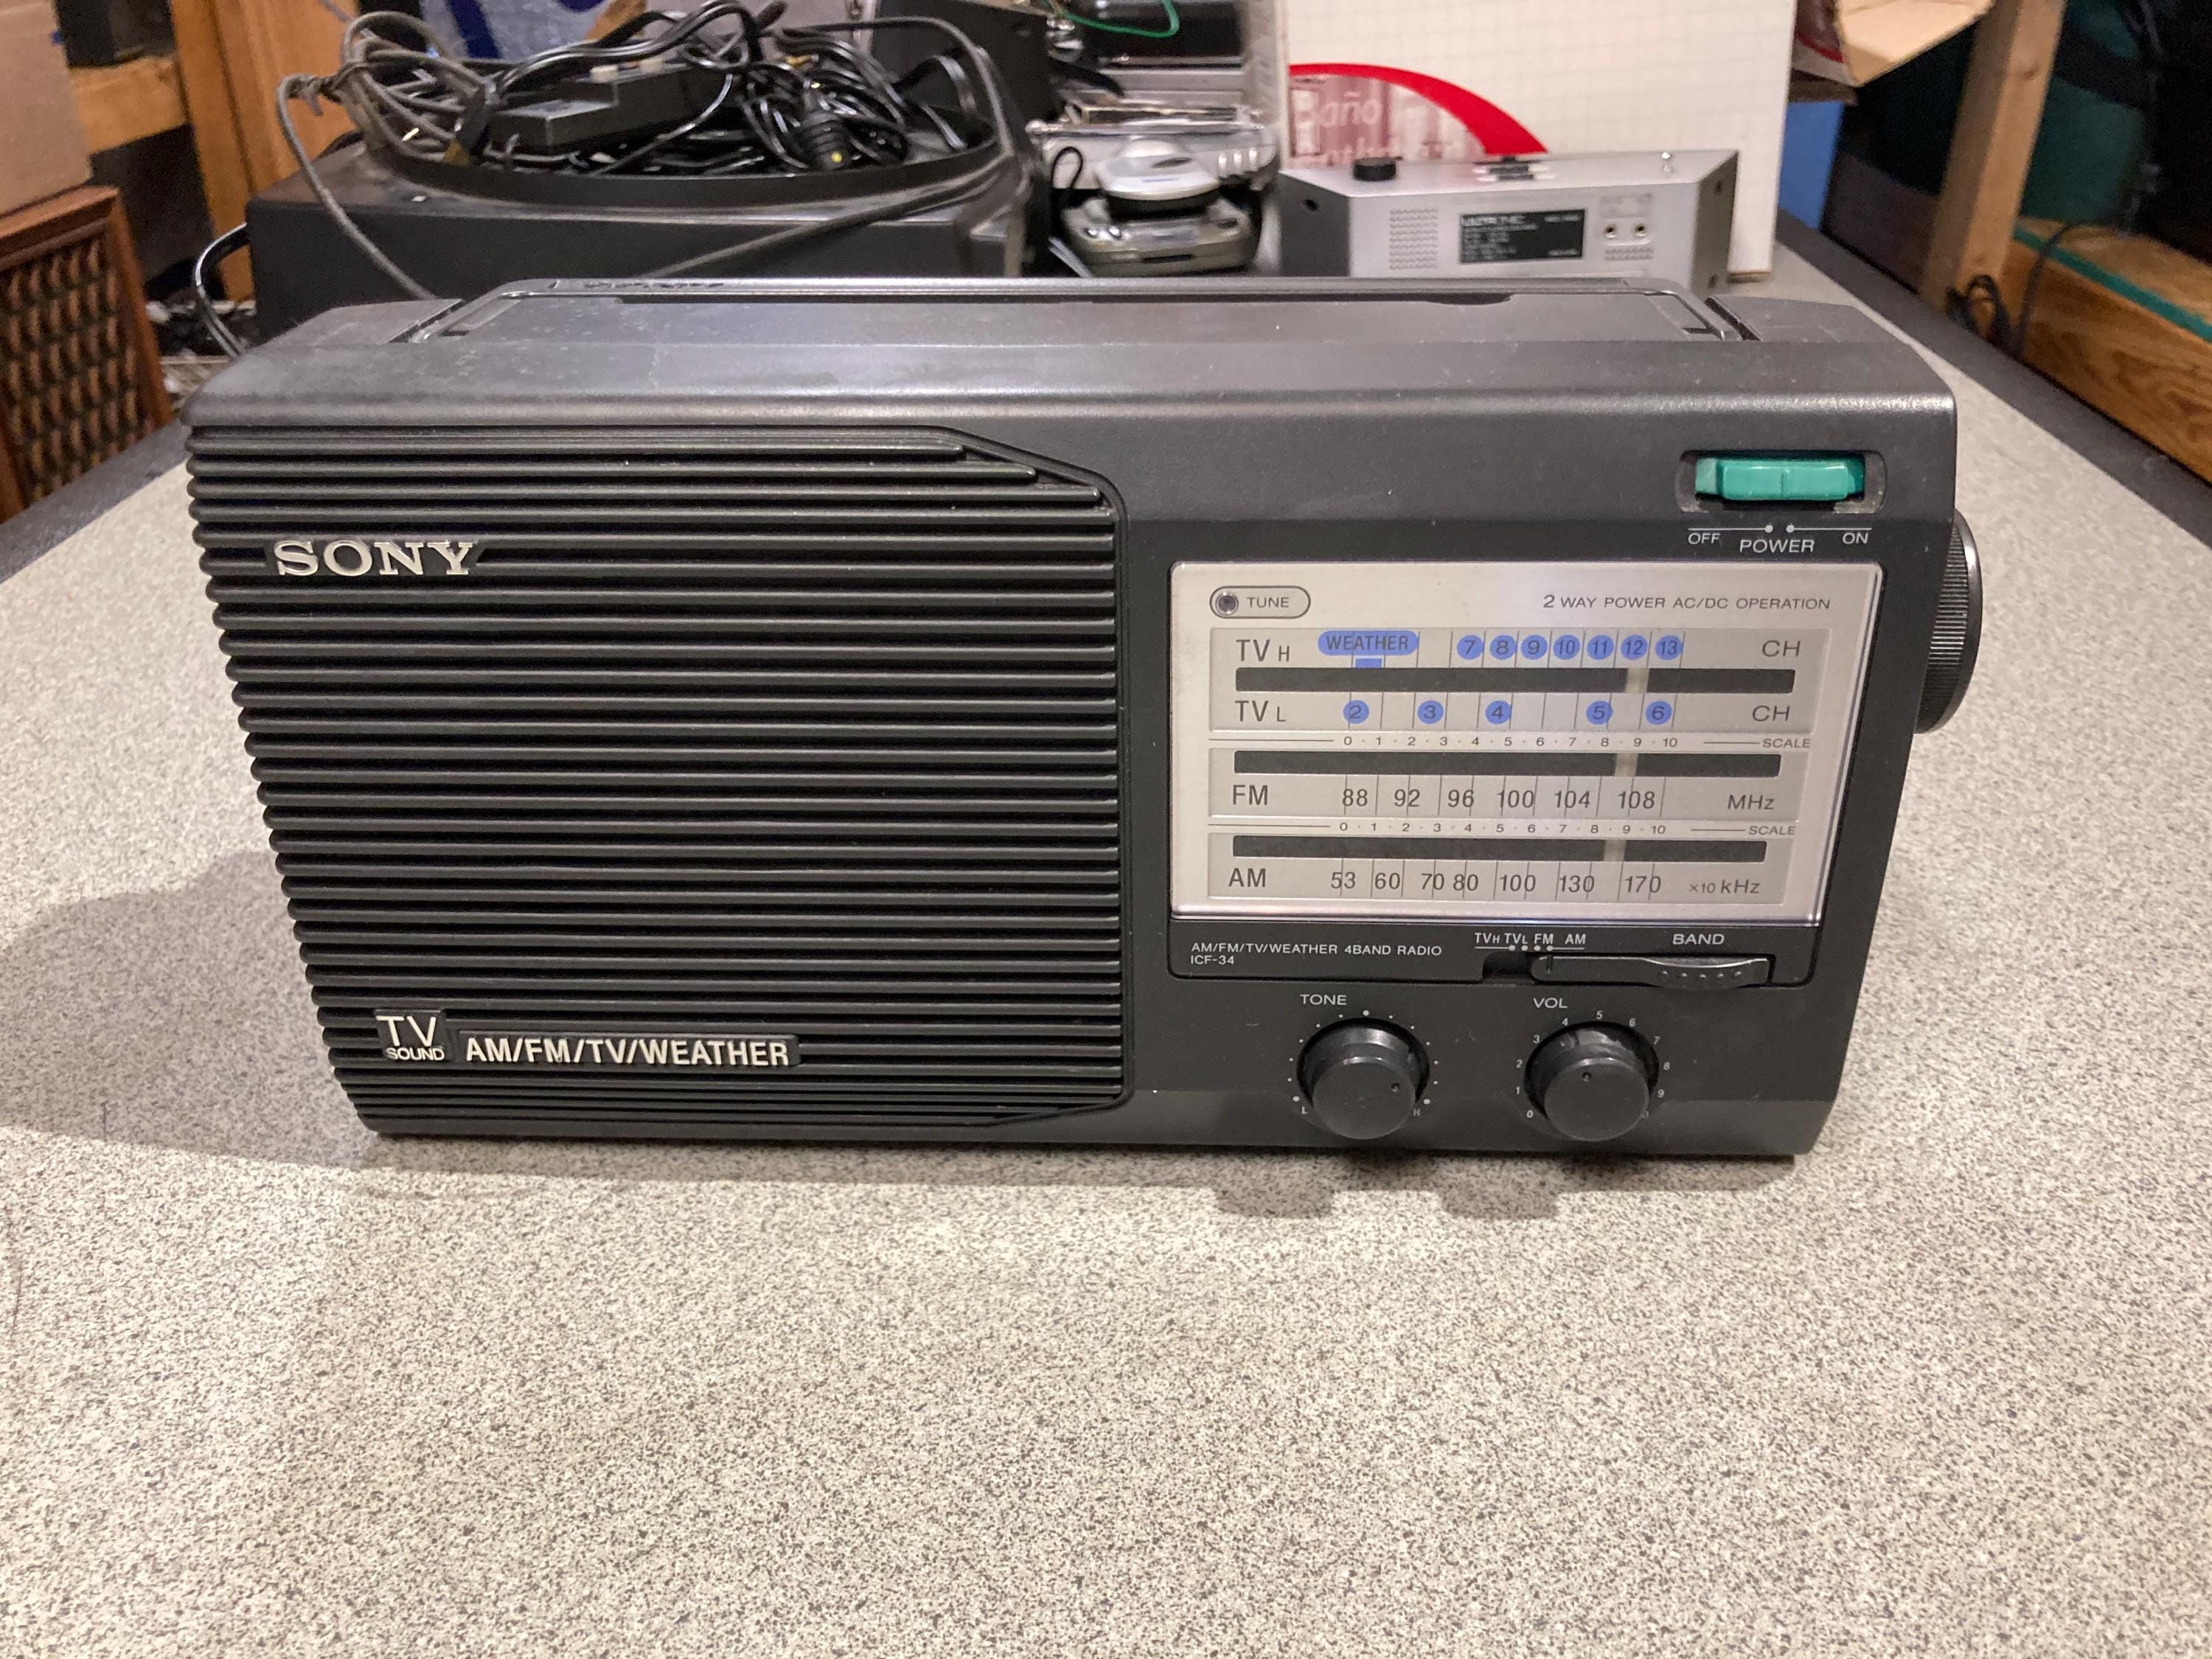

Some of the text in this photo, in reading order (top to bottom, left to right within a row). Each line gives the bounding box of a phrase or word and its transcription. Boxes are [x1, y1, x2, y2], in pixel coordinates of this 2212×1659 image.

[1688, 533, 1720, 544] OFF
[1843, 533, 1868, 544] ON
[1739, 539, 1815, 553] POWER
[274, 540, 473, 577] SONY
[1247, 597, 1290, 608] TUNE
[1543, 595, 1830, 609] 2 WAY POWER AC/DC OPERATION
[1326, 636, 1408, 650] WEATHER
[1464, 640, 1475, 655] 7
[1496, 641, 1508, 654] 8
[1527, 641, 1540, 654] 9
[1558, 641, 1576, 655] 10
[1593, 641, 1607, 655] 11
[1625, 641, 1643, 655] 12
[1660, 641, 1678, 655] 13
[1761, 640, 1801, 657] CH
[1349, 706, 1362, 719] 2
[1424, 706, 1436, 719] 3
[1491, 706, 1503, 719] 4
[1592, 706, 1605, 720] 5
[1652, 706, 1664, 720] 6
[1752, 705, 1790, 722] CH
[1376, 737, 1381, 746] 1
[1408, 737, 1416, 746] 2
[1439, 737, 1447, 746] 3
[1471, 737, 1479, 746] 4
[1503, 737, 1512, 746] 5
[1537, 737, 1544, 747] 6
[1569, 737, 1576, 747] 7
[1601, 737, 1609, 747] 8
[1633, 738, 1641, 747] 9
[1663, 738, 1677, 748] 10
[1762, 739, 1811, 748] SCALE
[1232, 785, 1775, 810] FM 88 92 96 100 104 108 MHz
[1371, 823, 1376, 832] 1
[1402, 823, 1410, 832] 2
[1433, 823, 1441, 832] 3
[1464, 823, 1472, 832] 4
[1496, 823, 1503, 832] 5
[1528, 824, 1535, 834] 6
[1559, 824, 1567, 834] 7
[1590, 825, 1599, 834] 8
[1623, 825, 1630, 835] 9
[1652, 825, 1666, 835] 10
[1748, 826, 1795, 835] SCALE
[1228, 868, 1266, 887] AM
[1330, 872, 1356, 889] 53
[1374, 872, 1399, 890] 60
[1421, 873, 1444, 890] 70
[1453, 874, 1478, 891] 80
[1499, 874, 1536, 891] 100
[1559, 875, 1594, 892] 130
[1626, 876, 1660, 893] 170
[1721, 879, 1760, 894] kHz
[1534, 933, 1554, 945] FM
[1565, 933, 1586, 945] AM
[1673, 934, 1725, 945] BAND
[1191, 943, 1441, 956] AM/FM/TV/WEATHER 4BAND RADIO
[1190, 956, 1234, 964] ICF-34
[1300, 995, 1347, 1005] TONE
[1533, 998, 1568, 1009] VOL
[1596, 1011, 1603, 1020] 5
[1629, 1018, 1636, 1026] 6
[377, 1015, 437, 1047] TV
[1534, 1035, 1540, 1043] 3
[1654, 1036, 1660, 1044] 7
[386, 1046, 444, 1061] SOUND
[466, 1037, 790, 1066] AM/FM/TV/WEATHER
[1516, 1060, 1523, 1068] 2
[1663, 1062, 1670, 1070] 8
[1658, 1090, 1665, 1098] 9
[1301, 1106, 1308, 1114] L
[1413, 1108, 1421, 1116] H
